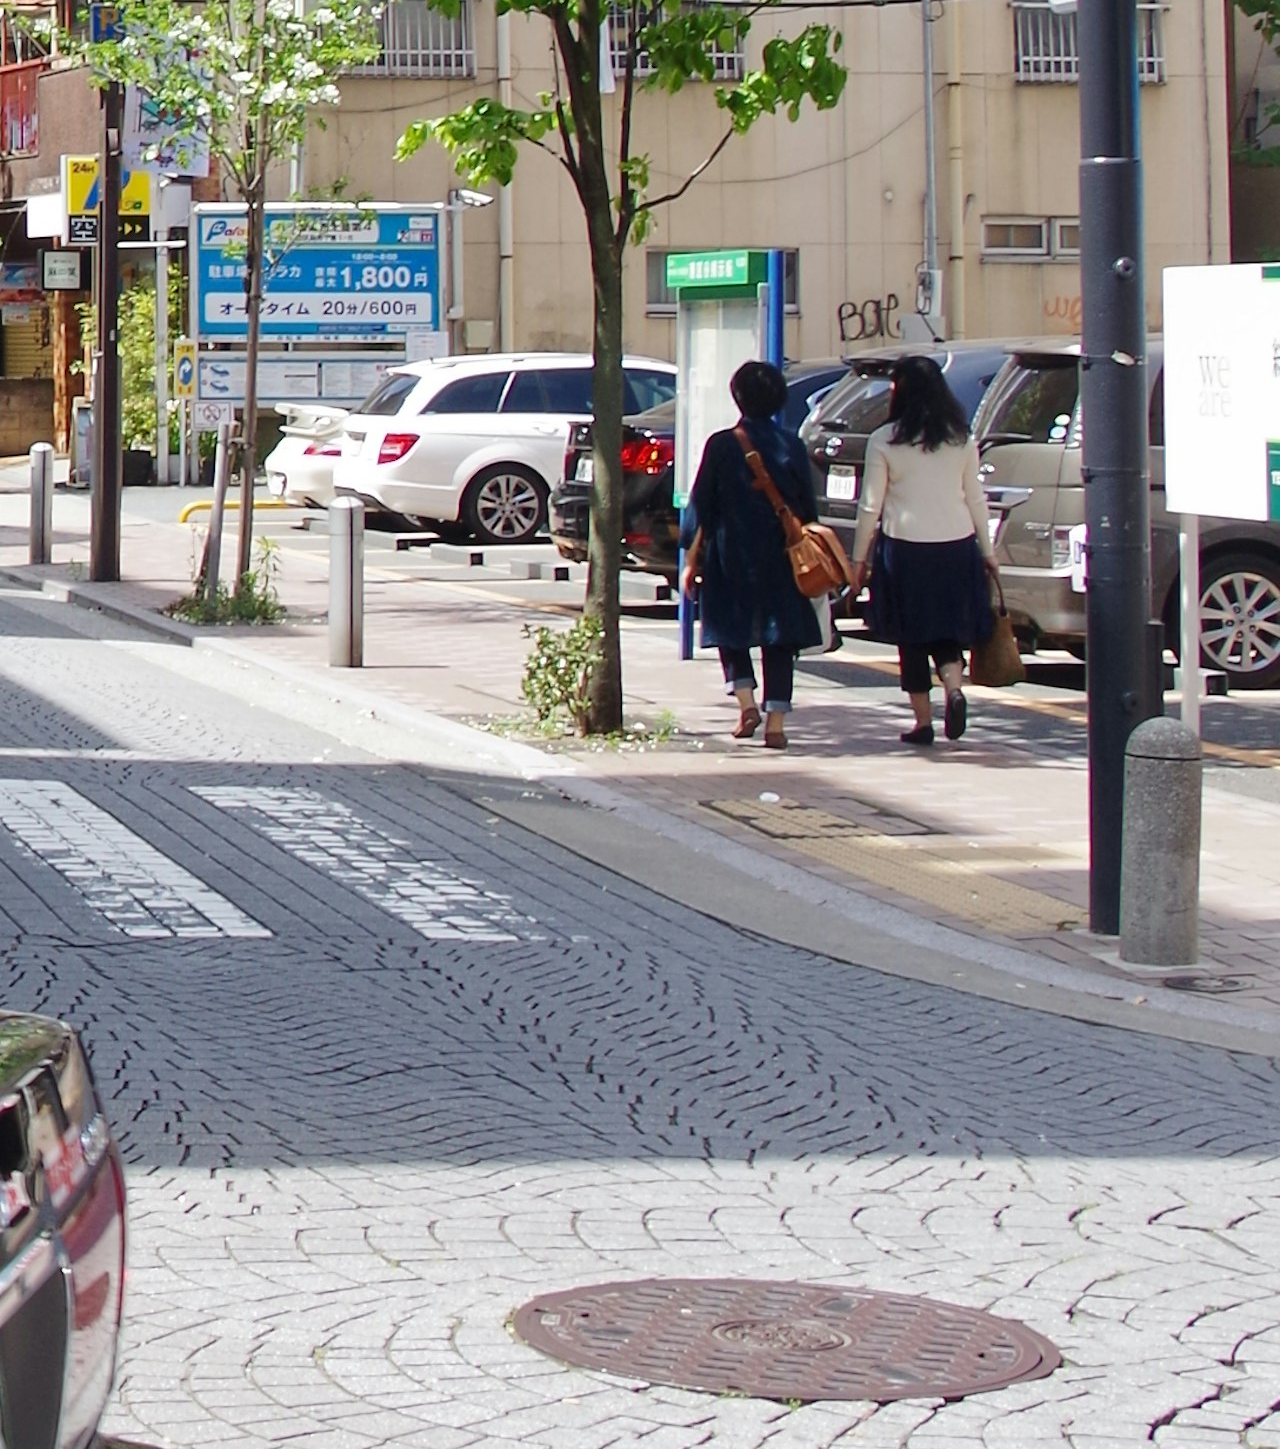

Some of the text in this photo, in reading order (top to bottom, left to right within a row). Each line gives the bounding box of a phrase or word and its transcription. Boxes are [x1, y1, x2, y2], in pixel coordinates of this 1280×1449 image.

[71, 215, 97, 241] 空
[220, 301, 311, 316] オータイム
[1198, 355, 1231, 389] we
[1198, 390, 1232, 418] are
